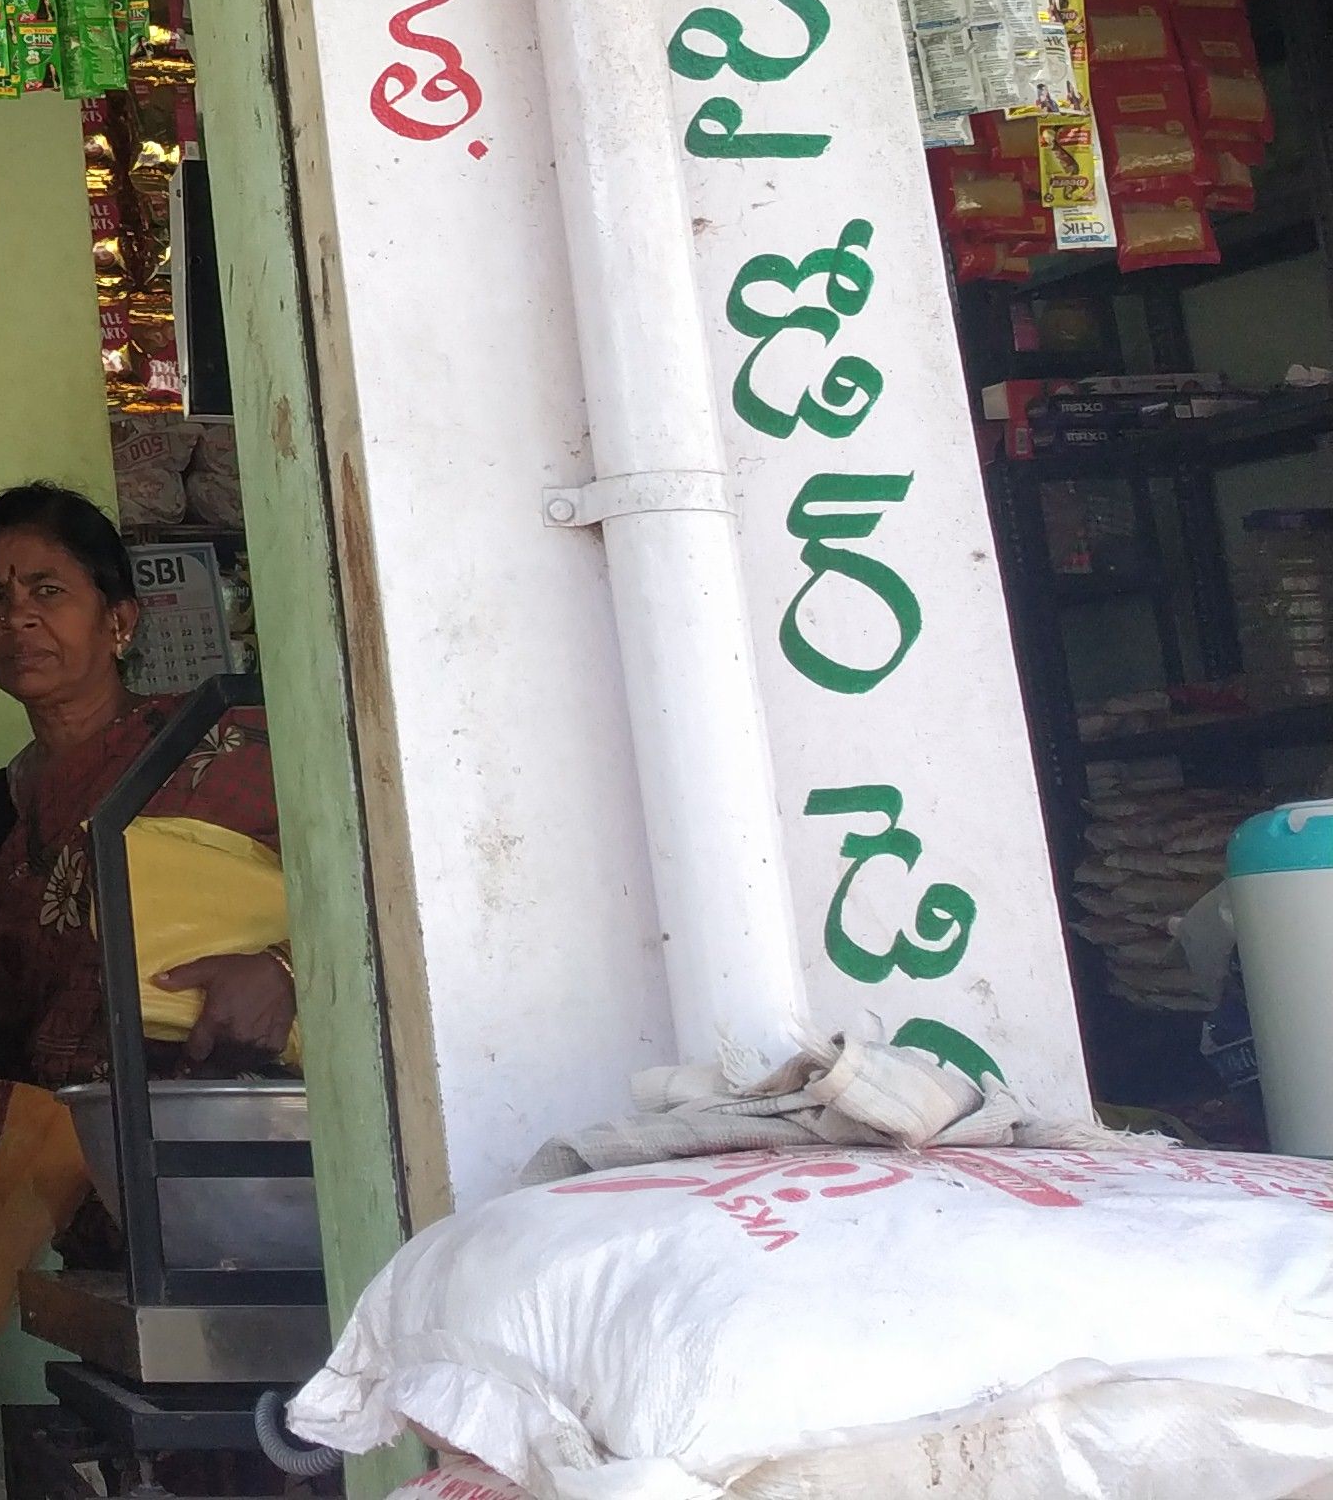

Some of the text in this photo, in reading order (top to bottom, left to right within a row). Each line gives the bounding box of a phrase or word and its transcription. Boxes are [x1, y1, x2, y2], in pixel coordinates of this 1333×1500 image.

[22, 33, 54, 46] CHIK
[1062, 220, 1106, 238] CHIK
[135, 556, 186, 588] SBI
